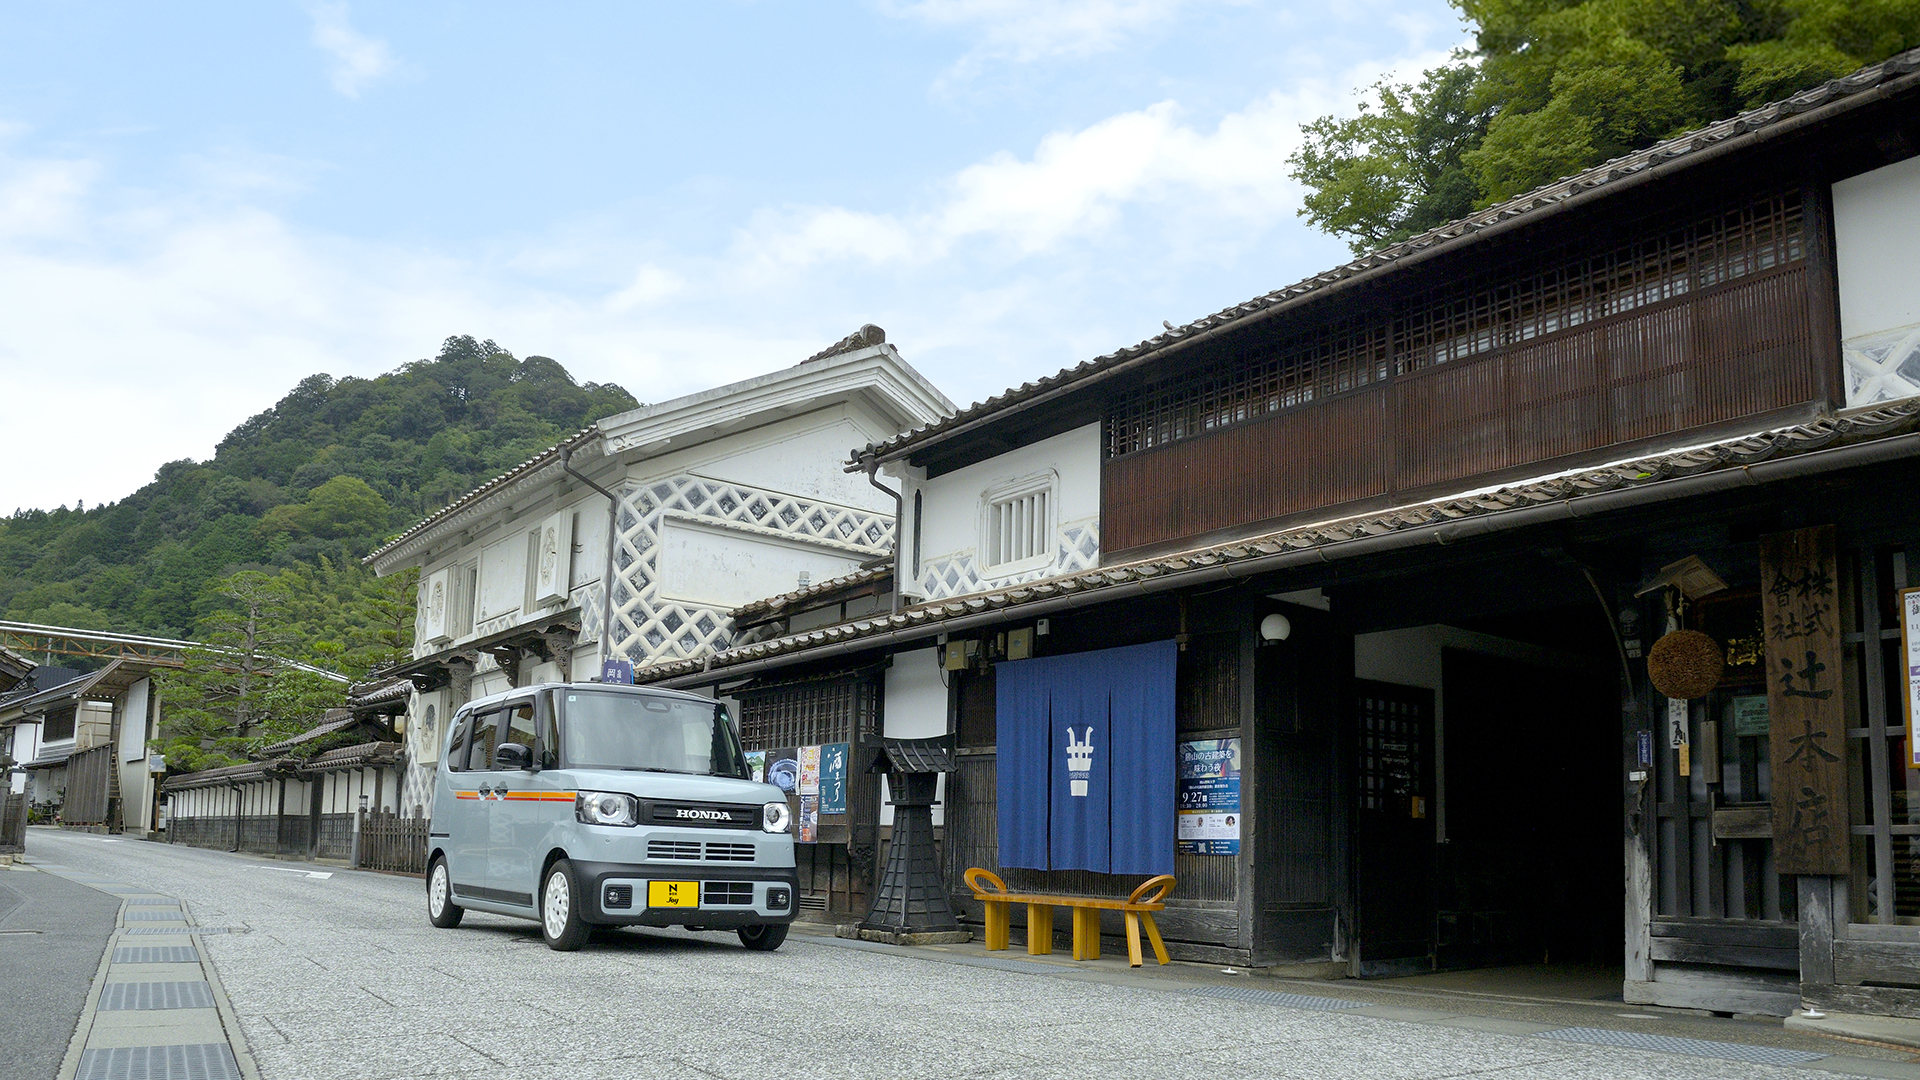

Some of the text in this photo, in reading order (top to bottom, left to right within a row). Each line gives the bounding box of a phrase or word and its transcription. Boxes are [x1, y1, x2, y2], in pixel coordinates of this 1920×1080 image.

[1768, 570, 1803, 643] 會社
[1796, 561, 1834, 640] 株式
[1779, 650, 1840, 846] 辻本店
[827, 747, 842, 802] 酒まつり
[1193, 763, 1221, 772] 味わう夜
[676, 808, 732, 821] HONDA
[666, 897, 679, 905] Joy
[668, 883, 678, 892] N
